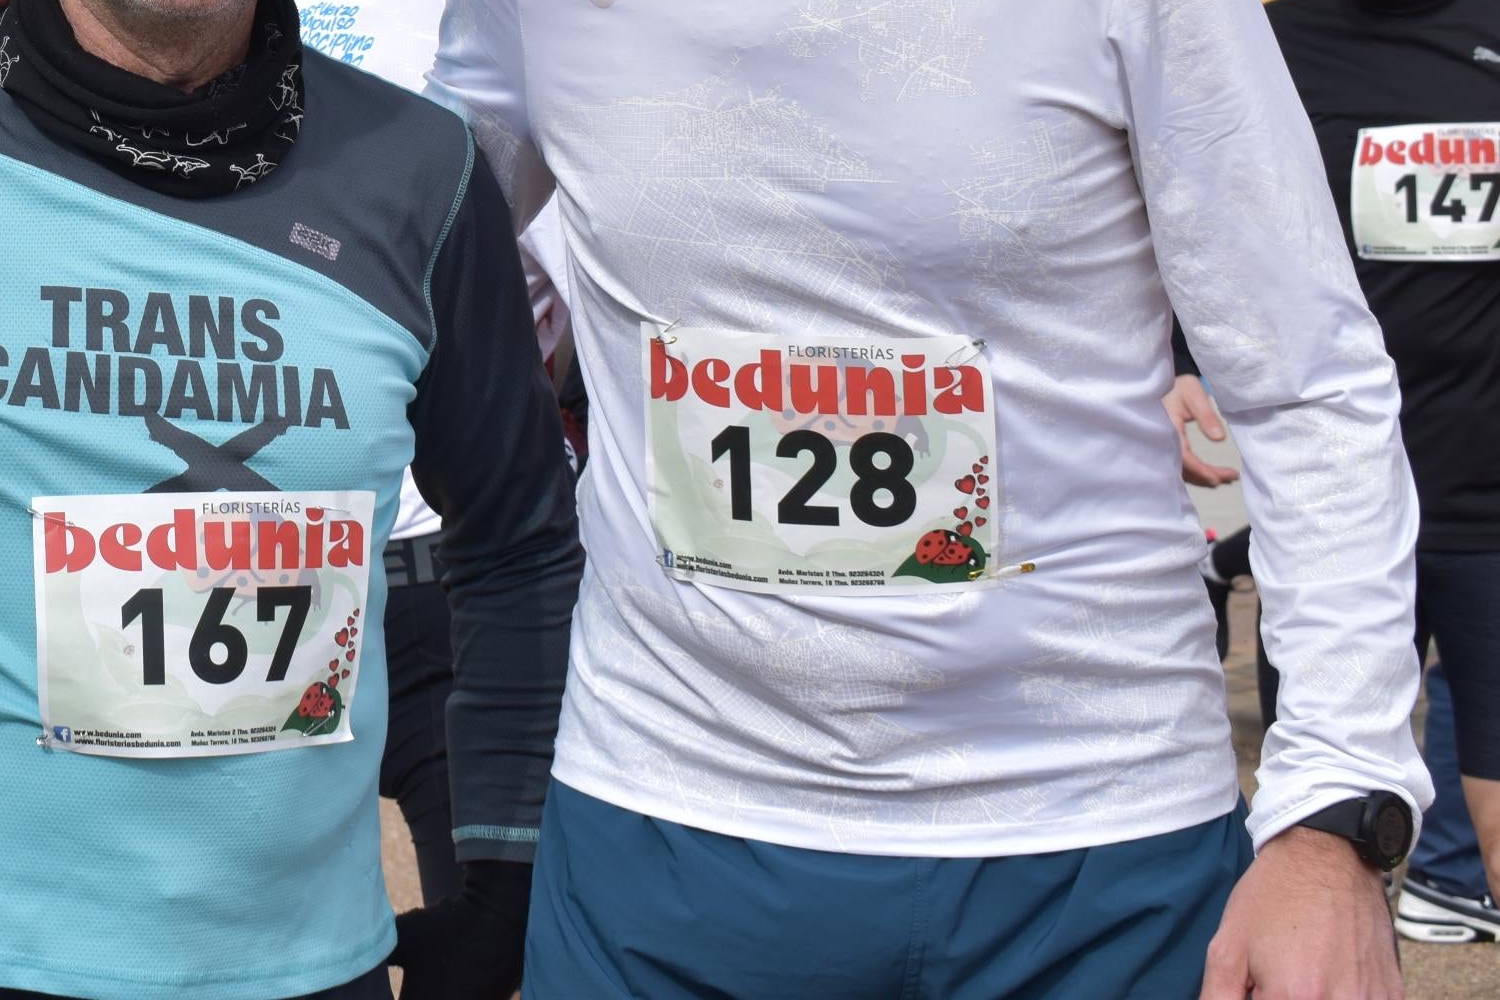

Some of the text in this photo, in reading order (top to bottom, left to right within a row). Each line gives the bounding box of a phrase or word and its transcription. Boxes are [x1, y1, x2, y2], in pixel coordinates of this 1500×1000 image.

[1359, 132, 1500, 166] bedun
[1395, 173, 1500, 223] 147
[40, 285, 285, 363] TRANS
[787, 344, 895, 361] FLORISTERÍAS
[650, 337, 985, 417] bedunia
[711, 425, 917, 528] 128
[202, 499, 301, 516] FLORISTERÍAS
[44, 506, 364, 574] bedunia
[121, 585, 312, 686] 167
[73, 729, 142, 739] www.bedunia.com
